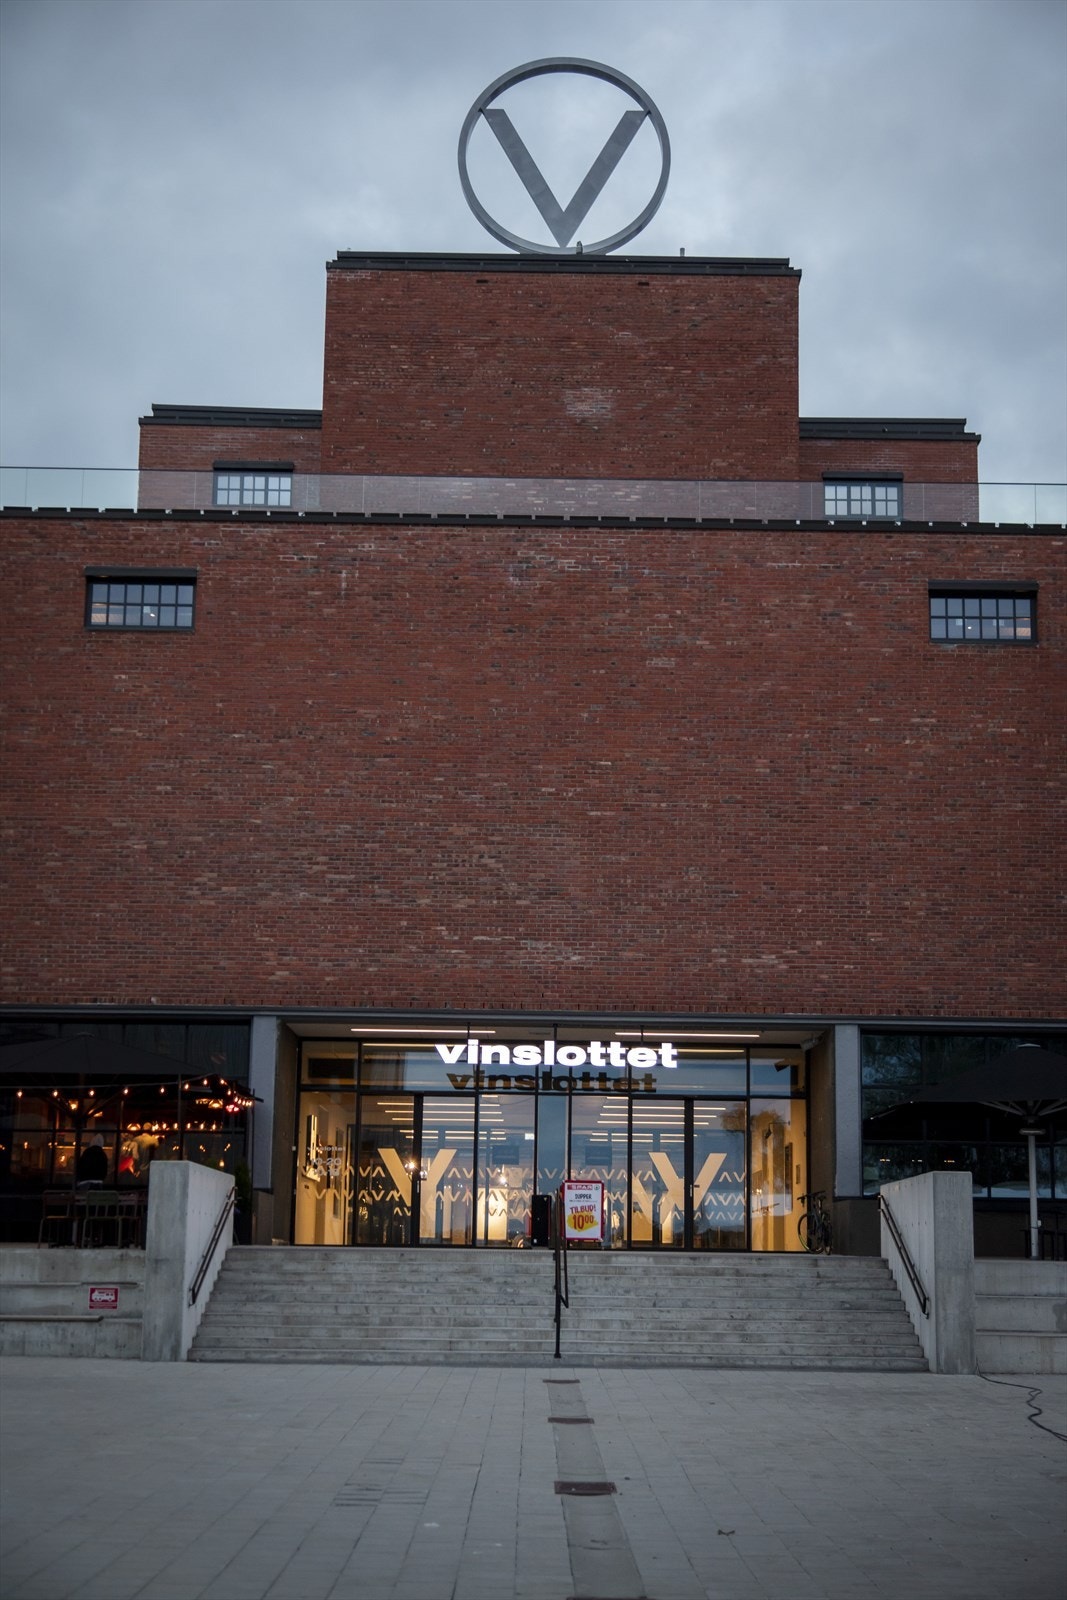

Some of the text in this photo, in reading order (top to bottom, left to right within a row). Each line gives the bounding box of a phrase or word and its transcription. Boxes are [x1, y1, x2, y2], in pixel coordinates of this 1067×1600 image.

[435, 1039, 677, 1068] vinslottet
[446, 1070, 657, 1093] vinslottet
[570, 1204, 597, 1214] TILBUD!
